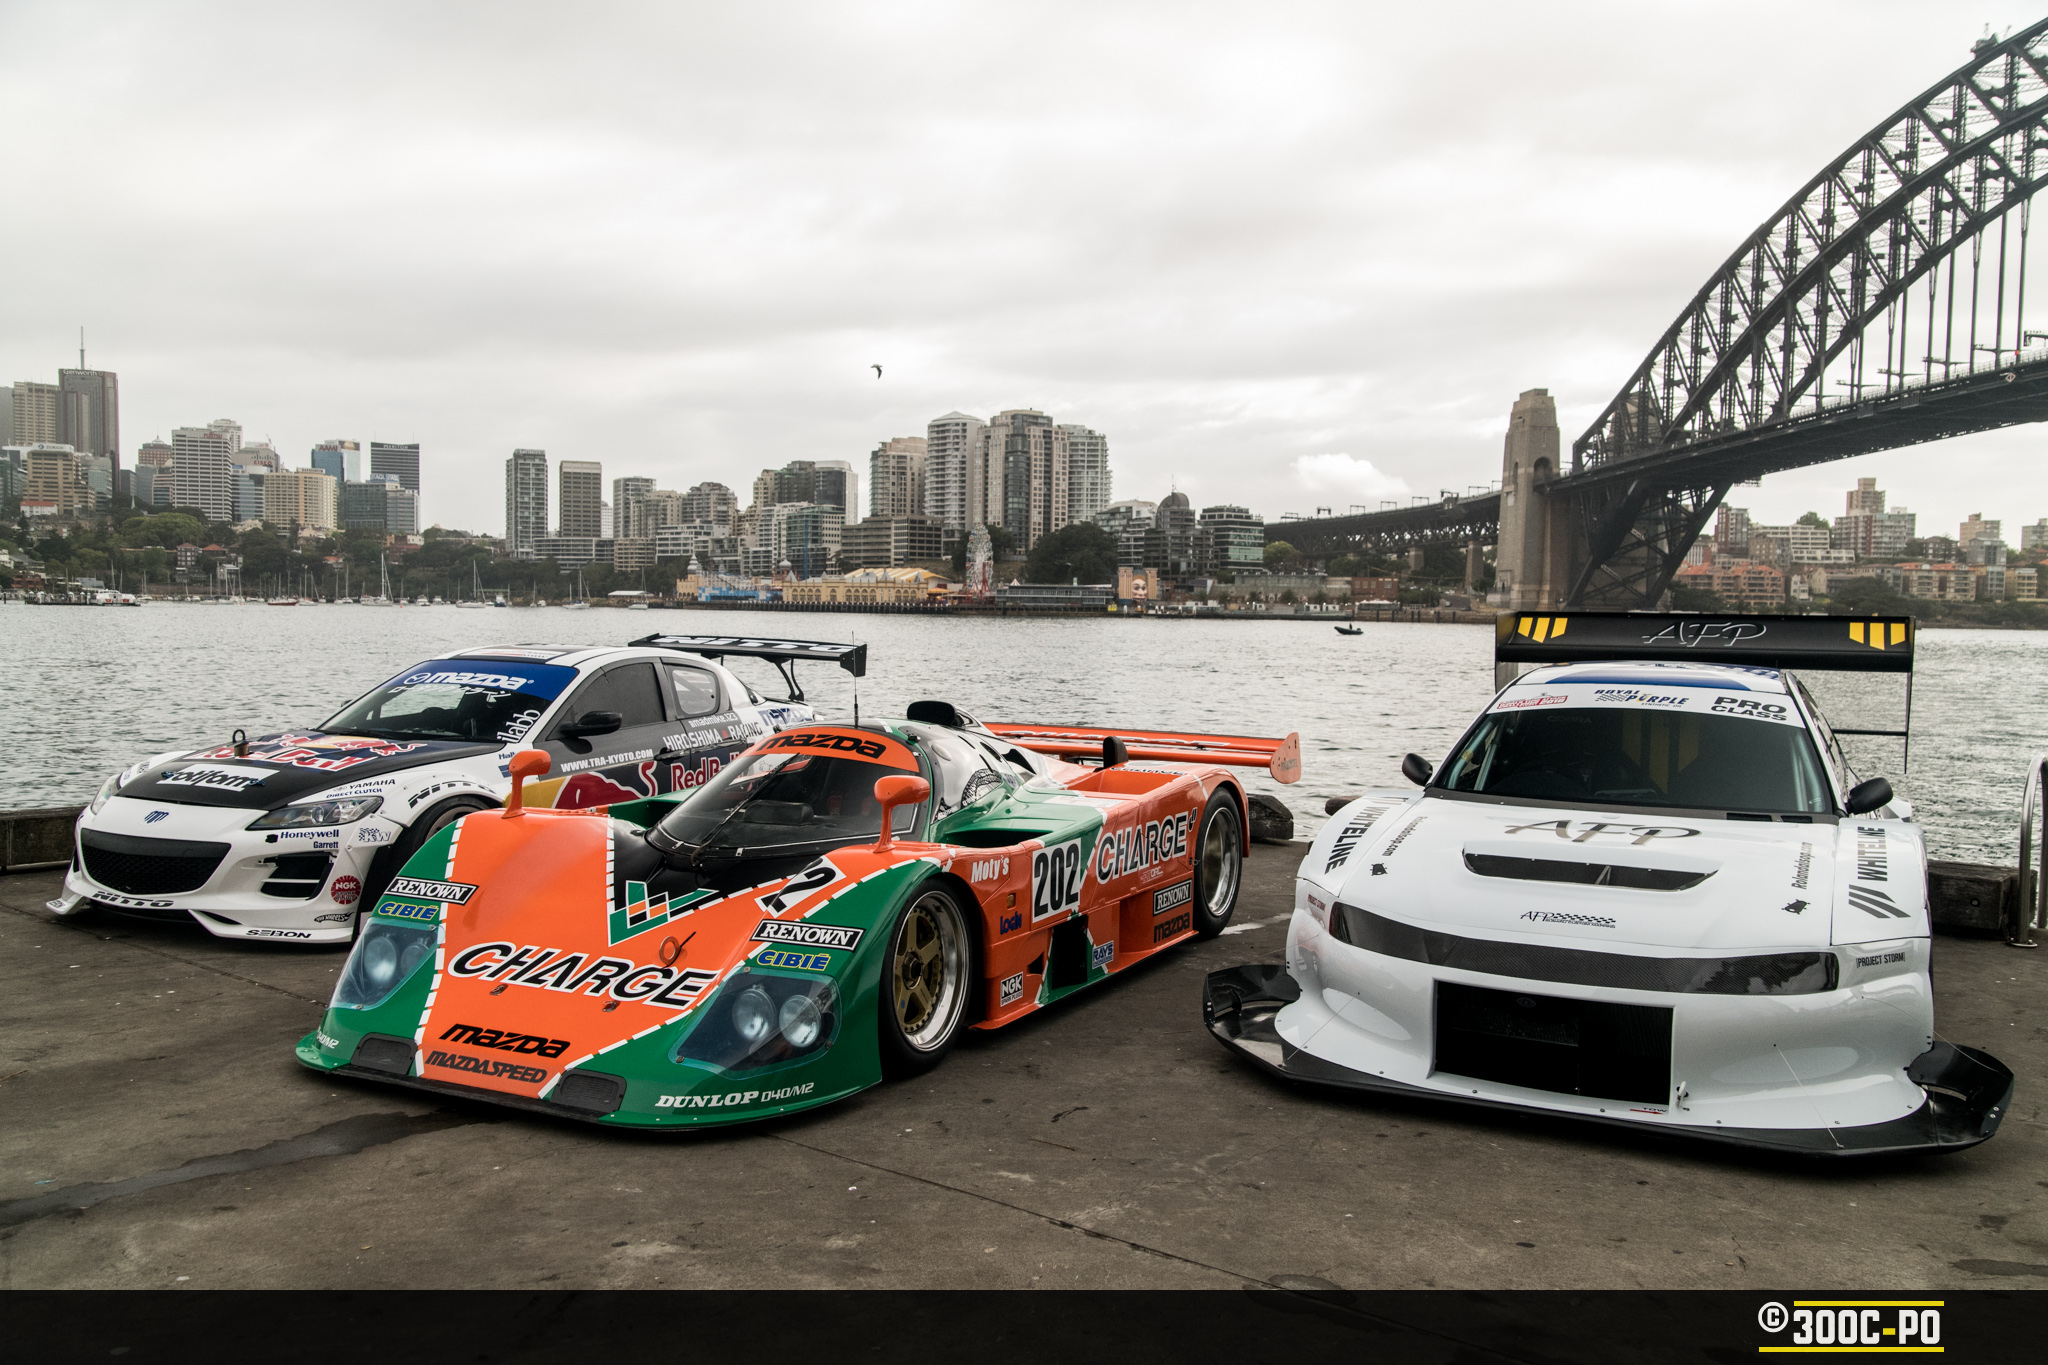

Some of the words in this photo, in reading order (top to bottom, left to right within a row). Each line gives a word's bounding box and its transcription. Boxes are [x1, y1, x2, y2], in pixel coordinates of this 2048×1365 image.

[1624, 694, 1690, 705] PURPLE
[1713, 696, 1788, 714] PRO
[1711, 706, 1788, 722] CLASS
[662, 729, 723, 751] HIROSHIMA
[728, 722, 763, 741] RACING
[560, 749, 653, 773] WWW.TRA-KYOTO.COM
[350, 779, 396, 790] YAMAHA
[280, 830, 340, 840] Honeywell
[313, 841, 338, 849] Garrett
[1324, 806, 1391, 875] WHITELINE
[1096, 812, 1188, 883] CHARGE
[1857, 826, 1888, 882] WHITELINE
[971, 855, 1010, 884] Moty's
[1033, 843, 1080, 918] 202
[392, 879, 466, 900] RENOWN
[1155, 883, 1191, 908] RENOWN
[760, 922, 853, 946] RENOWN
[447, 941, 724, 1010] CHARGE
[1001, 975, 1022, 996] NGK
[425, 1050, 547, 1084] MAZDASPEED
[655, 1091, 760, 1108] DUNLOP
